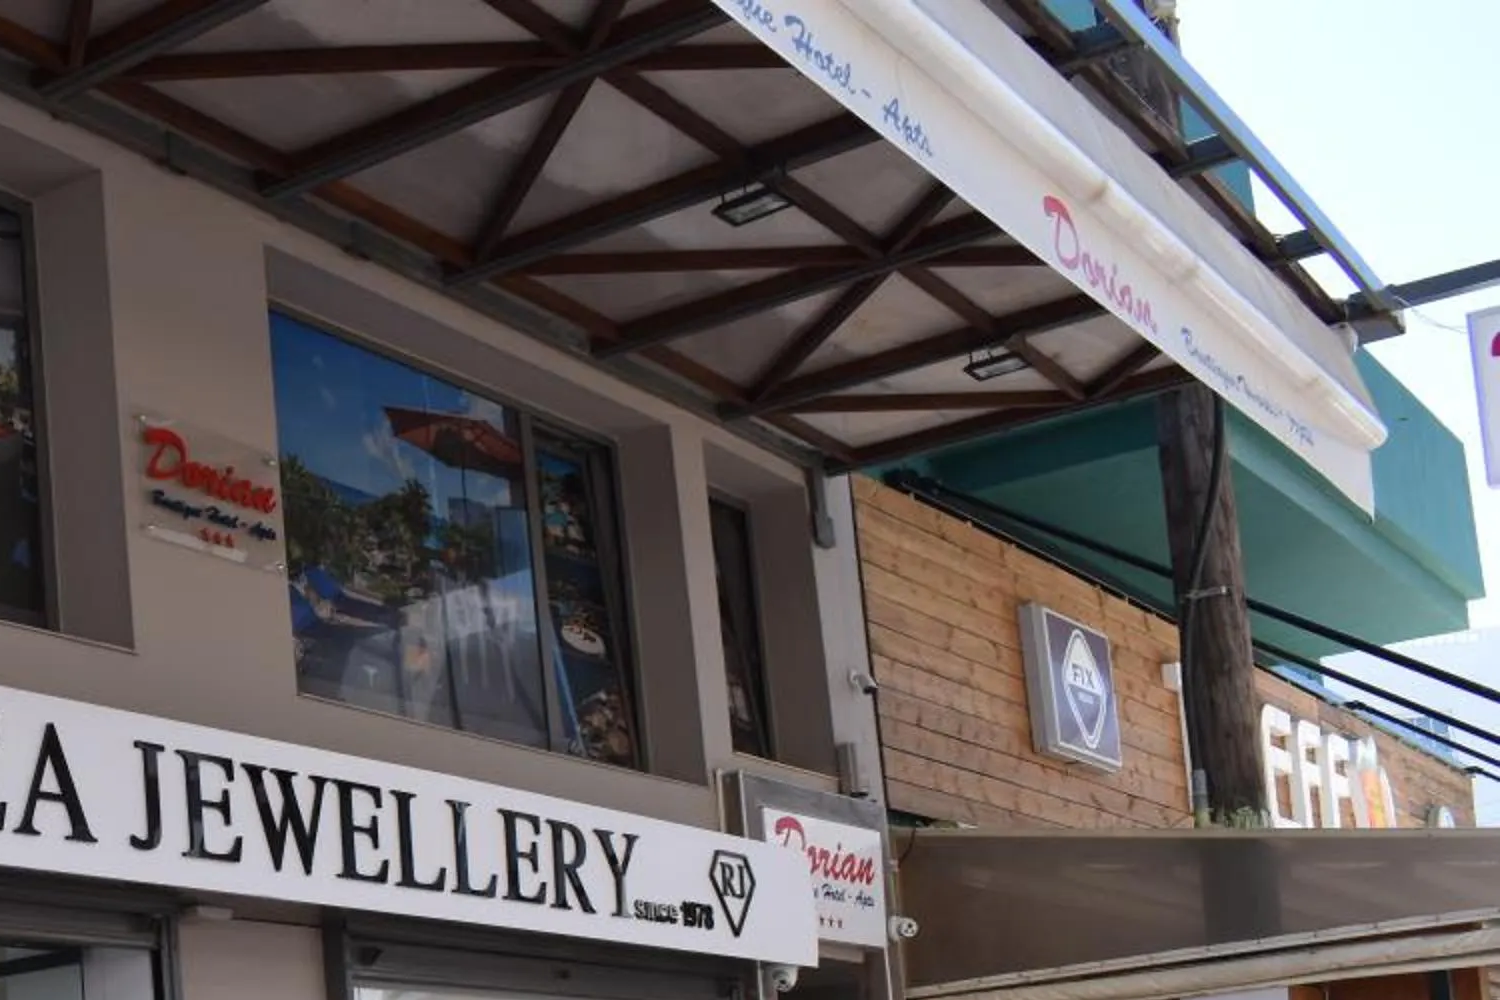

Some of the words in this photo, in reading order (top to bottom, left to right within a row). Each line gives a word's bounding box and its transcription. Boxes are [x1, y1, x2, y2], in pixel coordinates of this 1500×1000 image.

[1071, 663, 1096, 689] FIX
[129, 740, 641, 920] JEWELLERY
[719, 861, 747, 900] RJ
